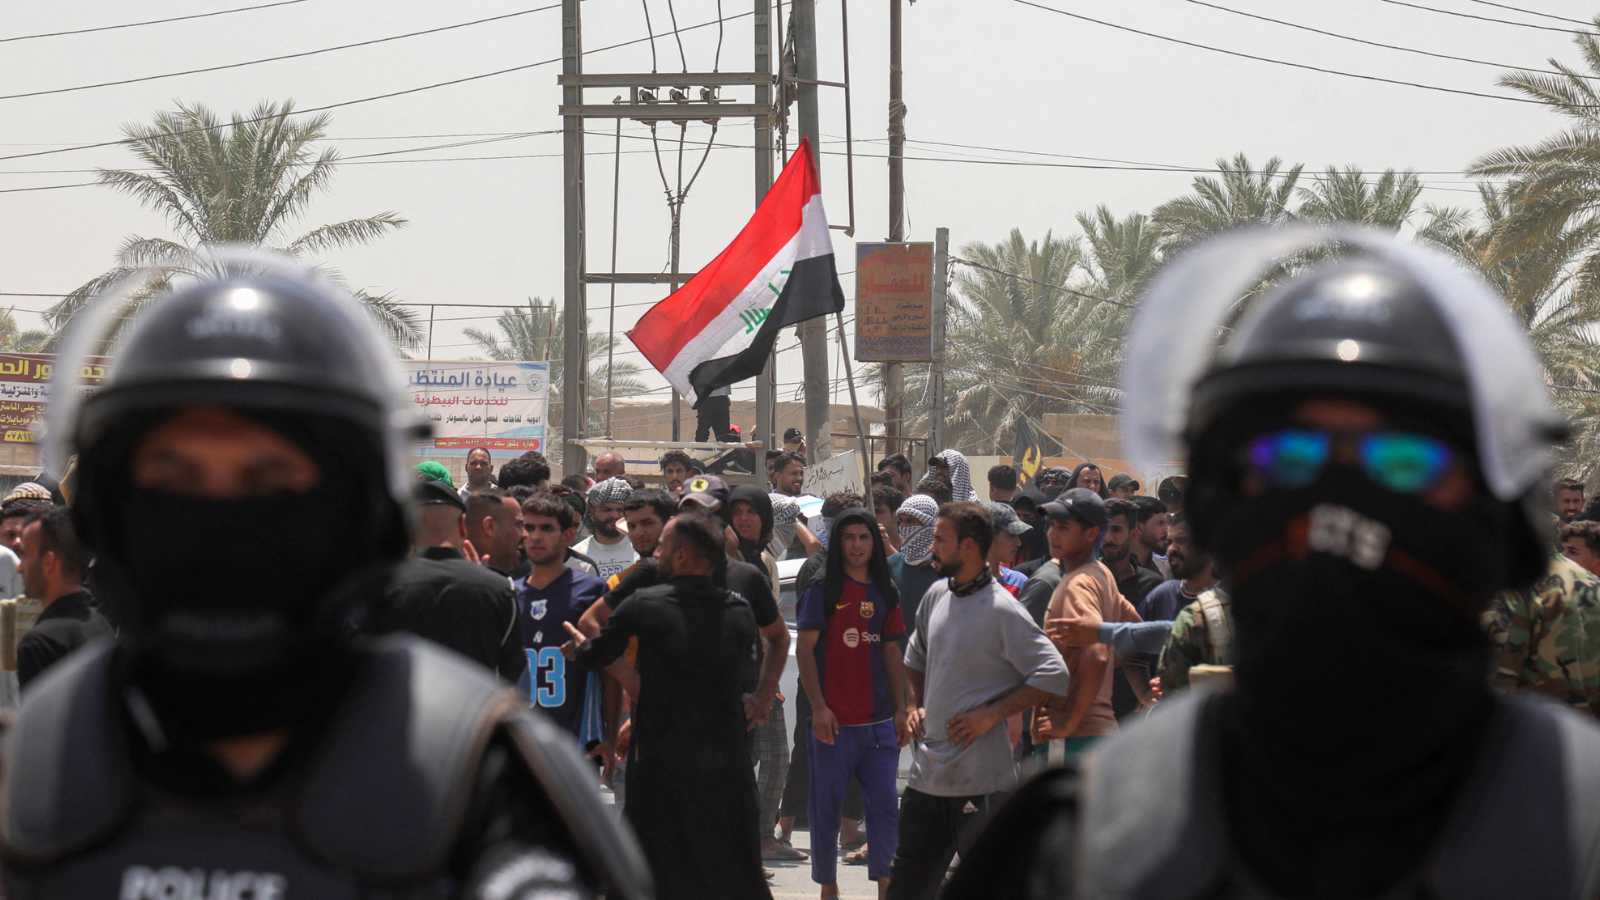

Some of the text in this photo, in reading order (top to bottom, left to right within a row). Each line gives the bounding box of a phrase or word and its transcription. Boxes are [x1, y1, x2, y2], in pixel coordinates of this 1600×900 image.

[475, 370, 517, 392] عيادة
[415, 394, 509, 407] للخدمات البيطرية
